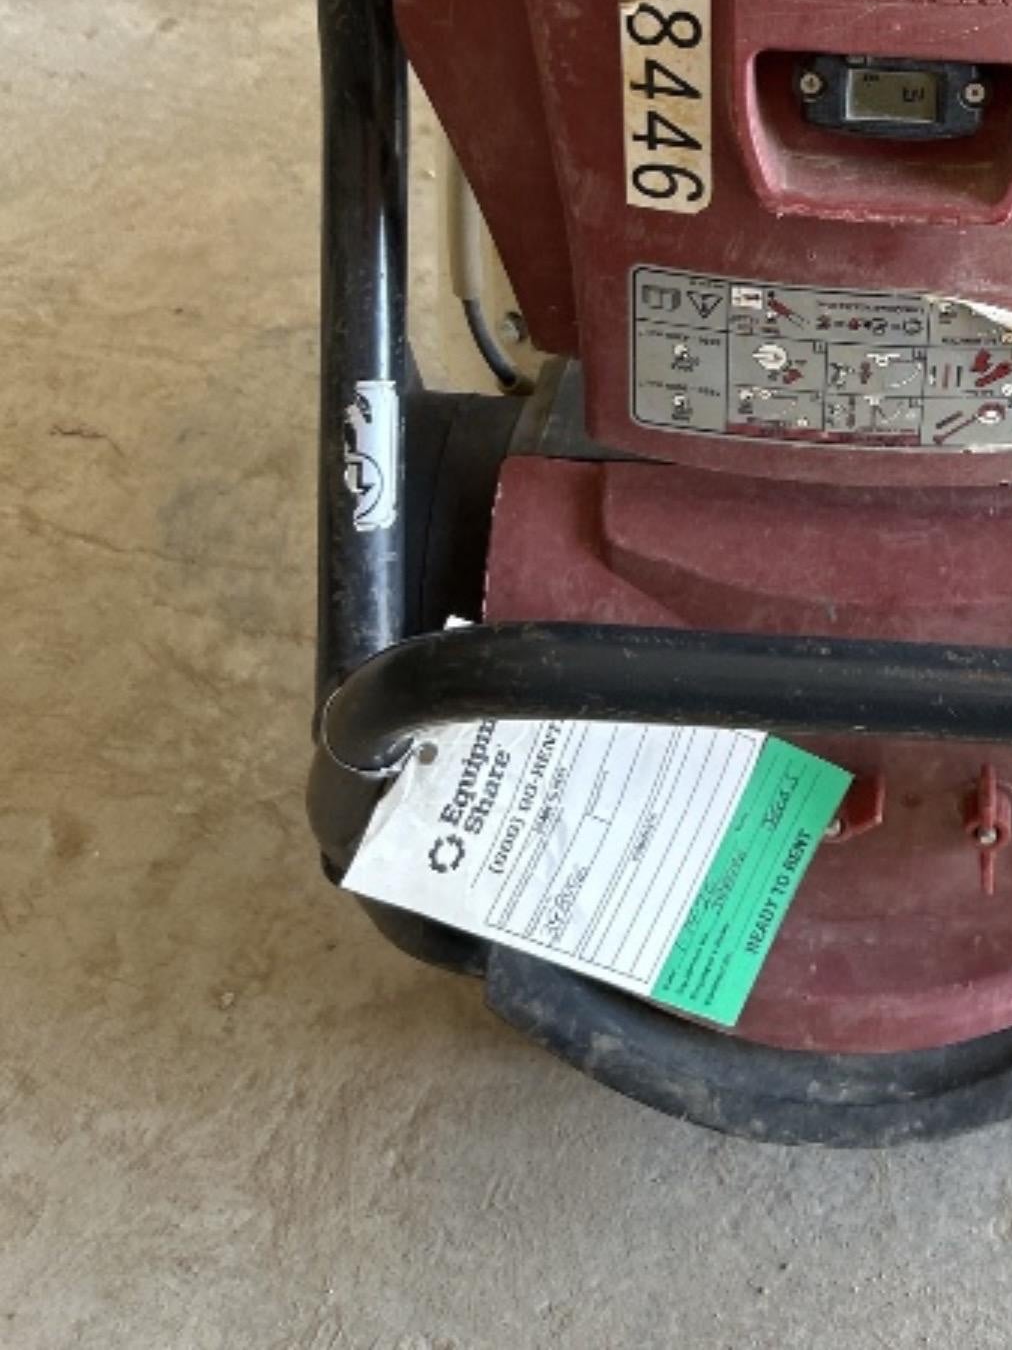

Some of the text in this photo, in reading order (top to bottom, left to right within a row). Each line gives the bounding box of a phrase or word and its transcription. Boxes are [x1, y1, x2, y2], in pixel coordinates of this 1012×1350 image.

[464, 750, 511, 835] Share
[746, 827, 813, 954] READY TO RENT
